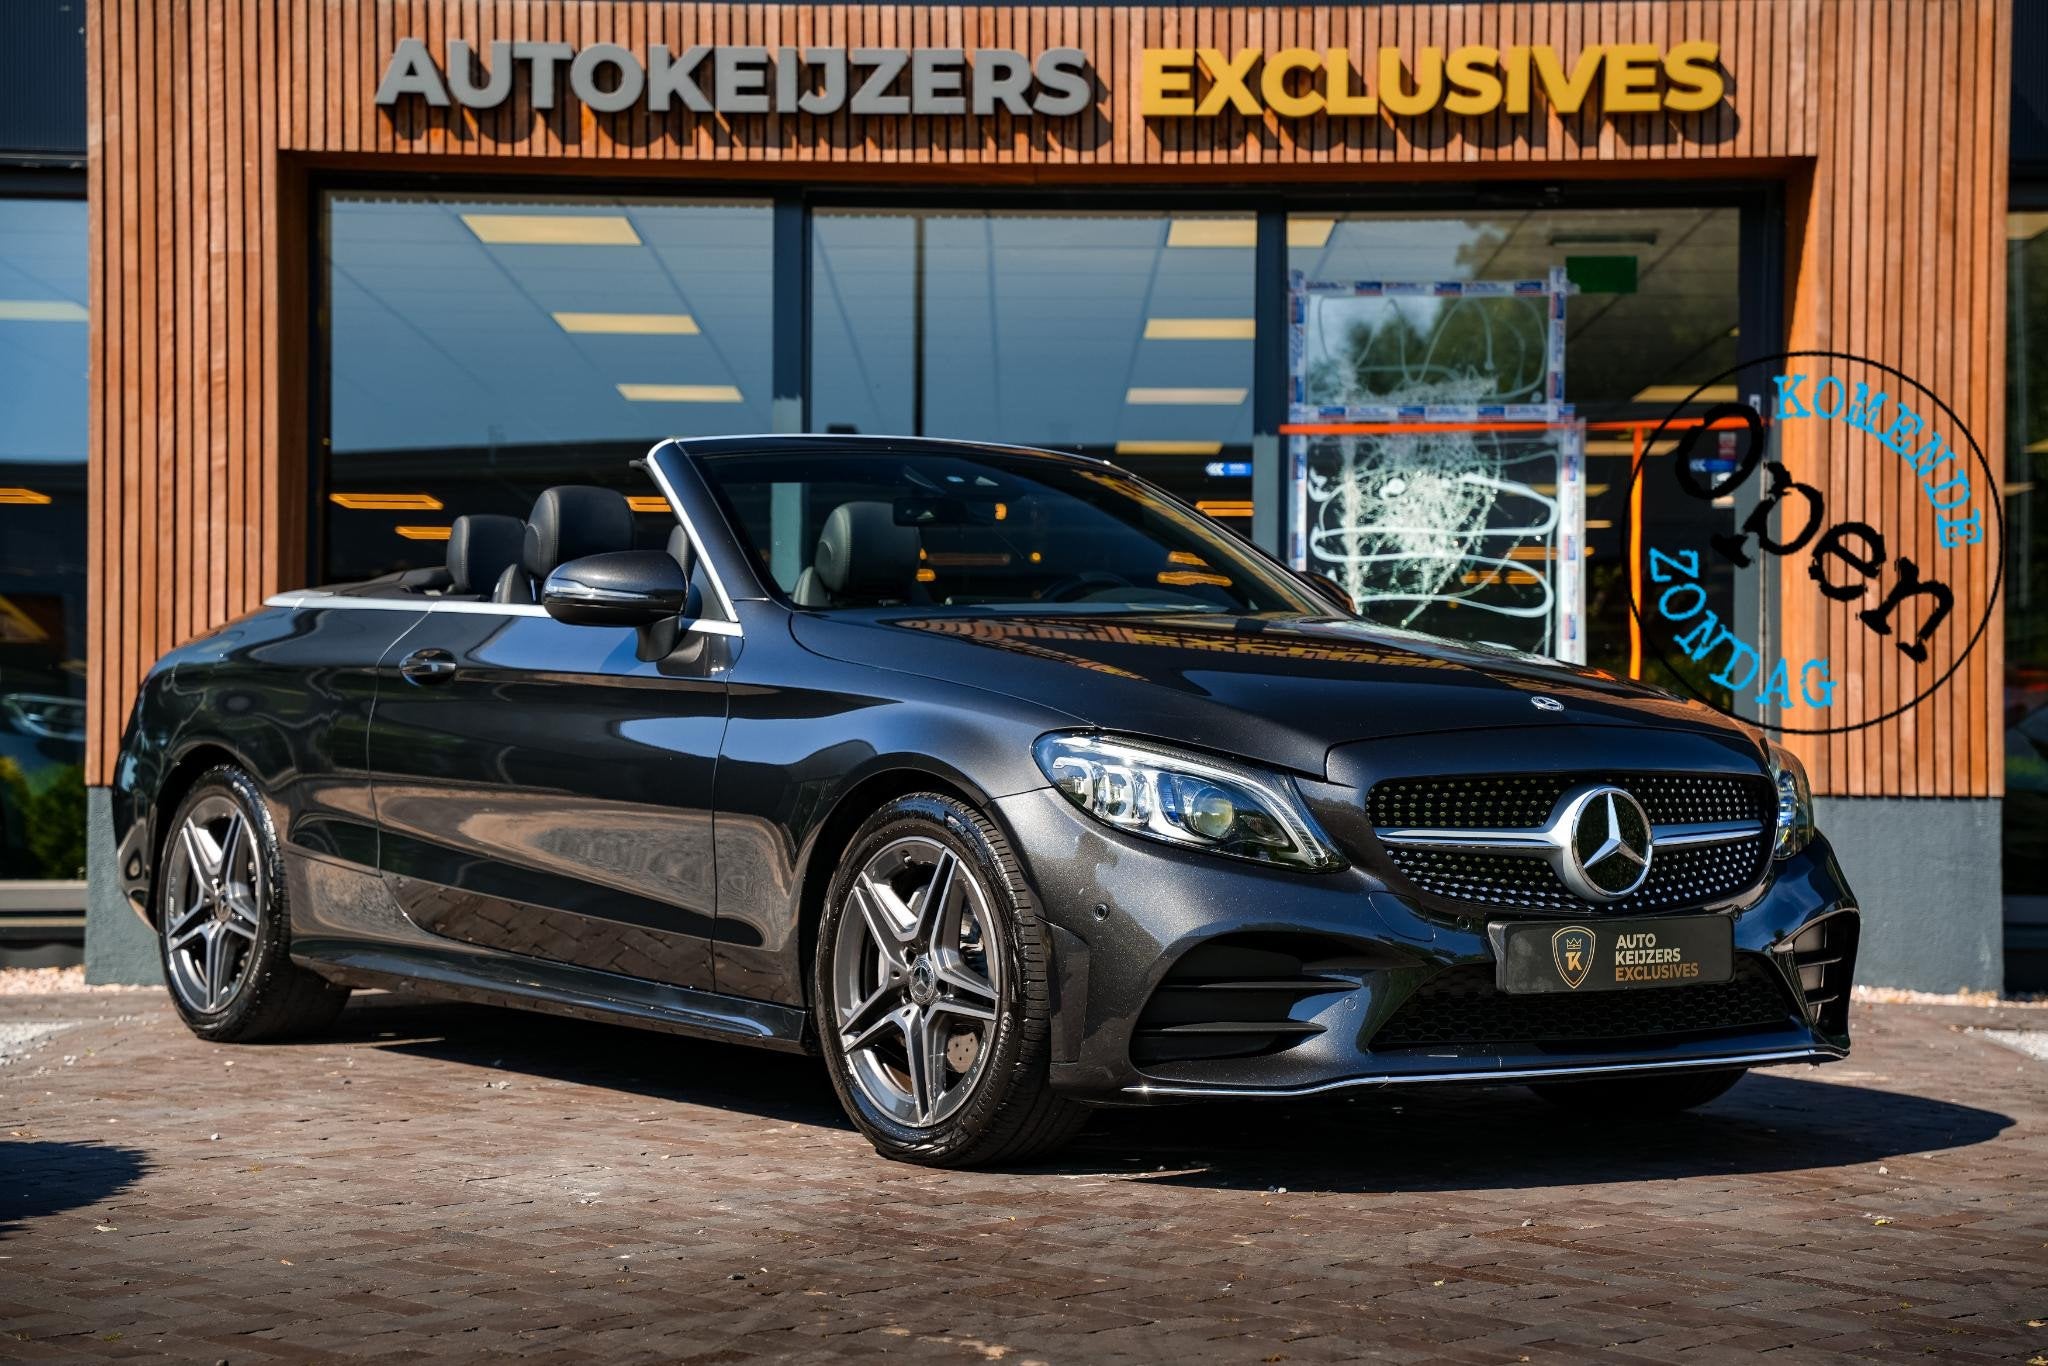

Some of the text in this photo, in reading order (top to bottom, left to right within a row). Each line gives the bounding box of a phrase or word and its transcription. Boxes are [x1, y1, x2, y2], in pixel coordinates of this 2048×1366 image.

[375, 37, 1724, 117] AUTOKEIJZERS EXCLUSIVES
[1616, 933, 1656, 949] AUTO
[1615, 948, 1681, 965] KEIJZERS
[1615, 963, 1699, 981] EXCLUSIVES
